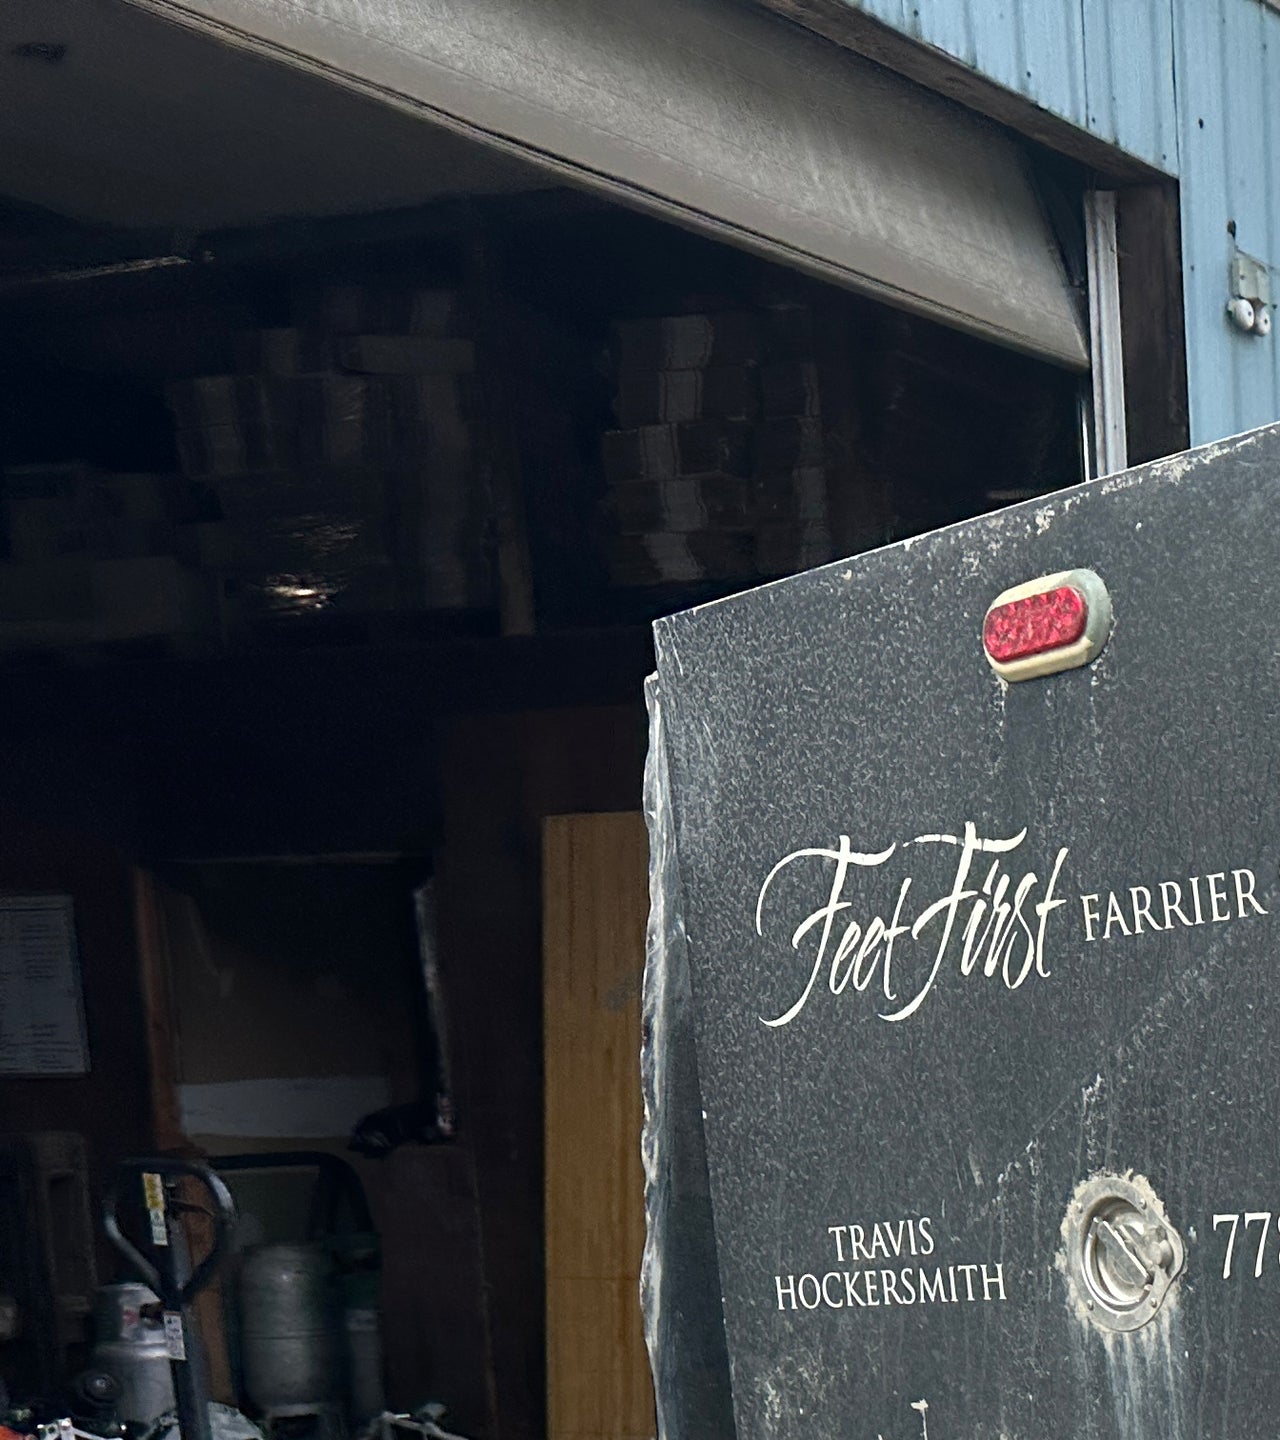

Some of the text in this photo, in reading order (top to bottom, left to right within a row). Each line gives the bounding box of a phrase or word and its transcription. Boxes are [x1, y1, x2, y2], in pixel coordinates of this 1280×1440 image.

[755, 834, 911, 1027] Feet
[877, 820, 1069, 1022] First
[1079, 867, 1269, 942] FARRIER
[827, 1216, 936, 1262] TRAVIS
[774, 1262, 1008, 1311] HOCKERSMITH
